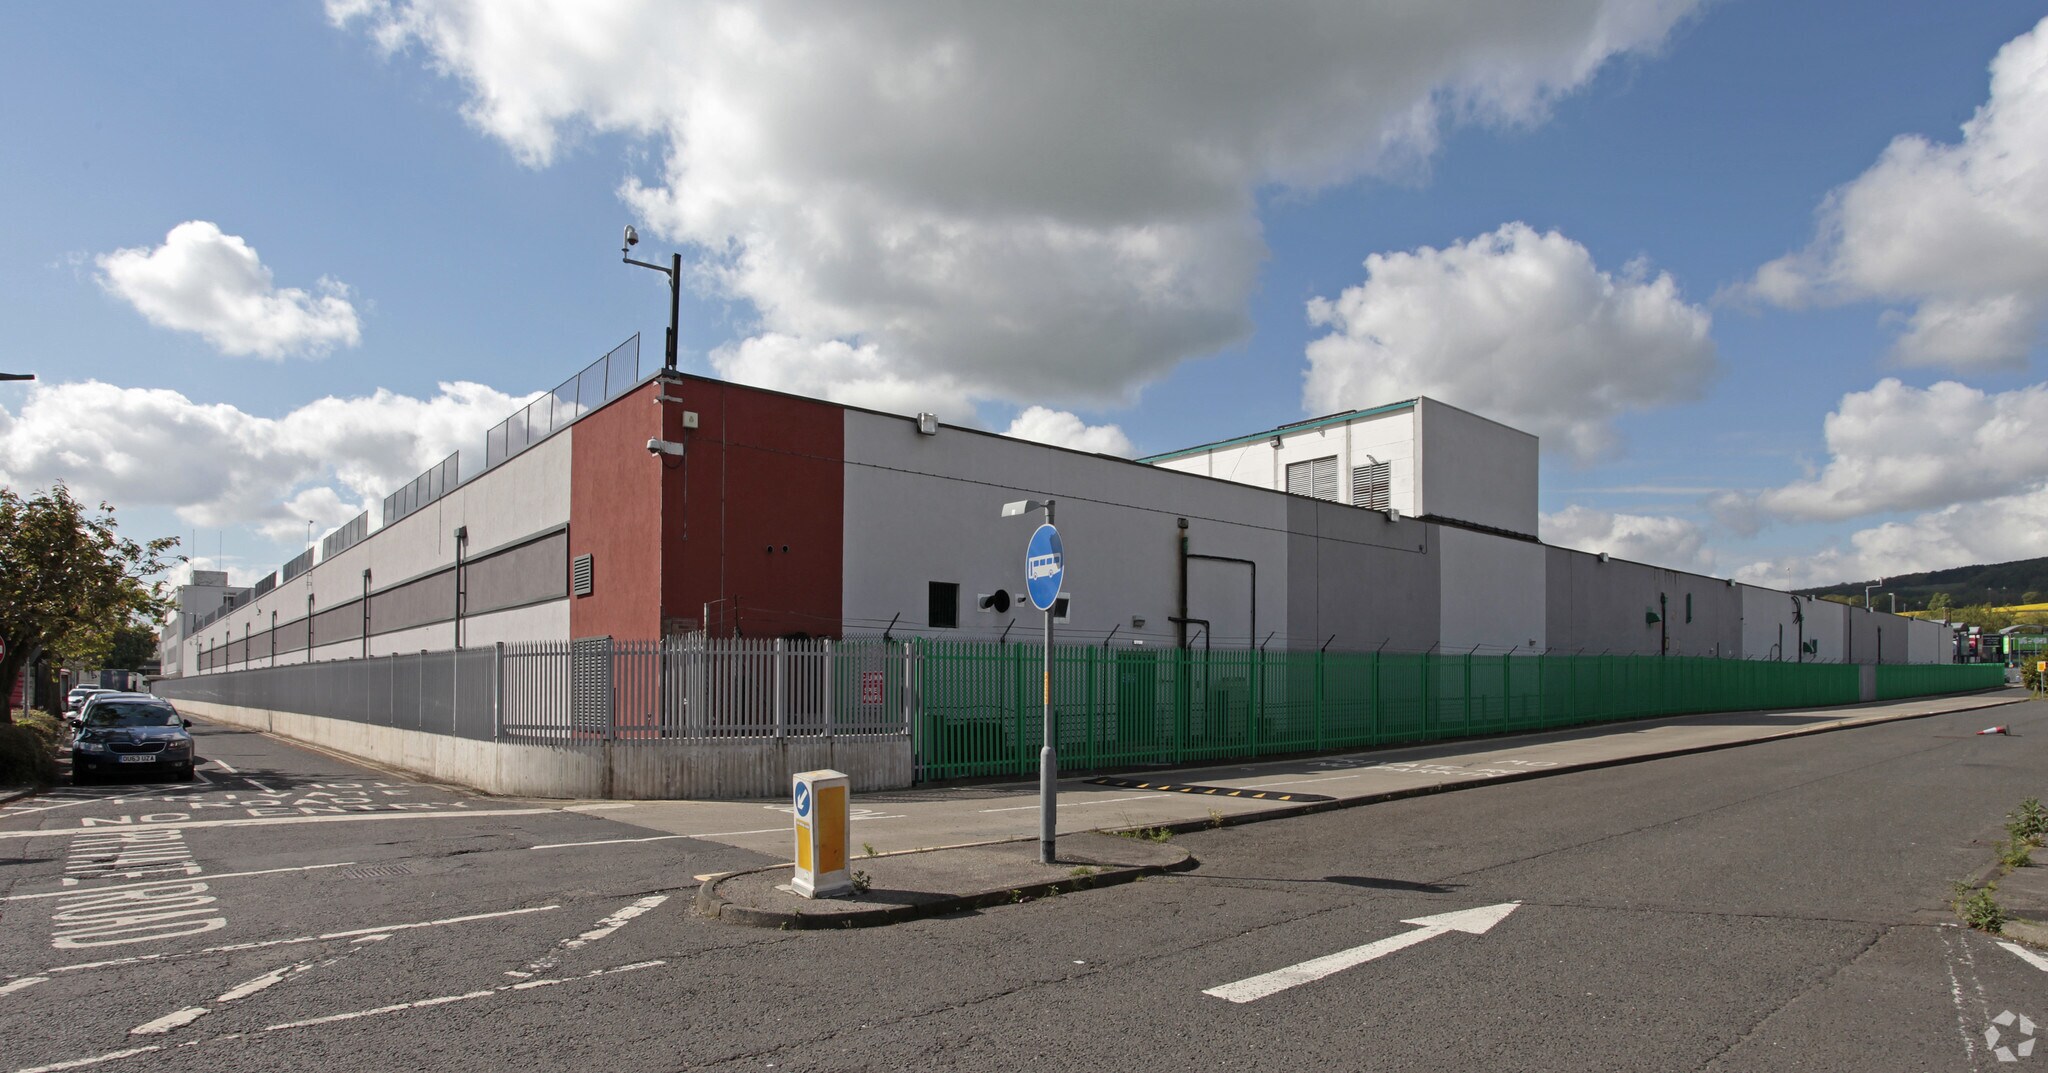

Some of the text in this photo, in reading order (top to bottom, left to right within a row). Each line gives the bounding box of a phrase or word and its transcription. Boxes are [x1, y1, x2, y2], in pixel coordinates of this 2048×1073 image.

[113, 790, 413, 804] PRIVATE
[190, 798, 374, 809] ROAD
[81, 801, 469, 826] NO ENTRY
[51, 882, 227, 949] ROAD
